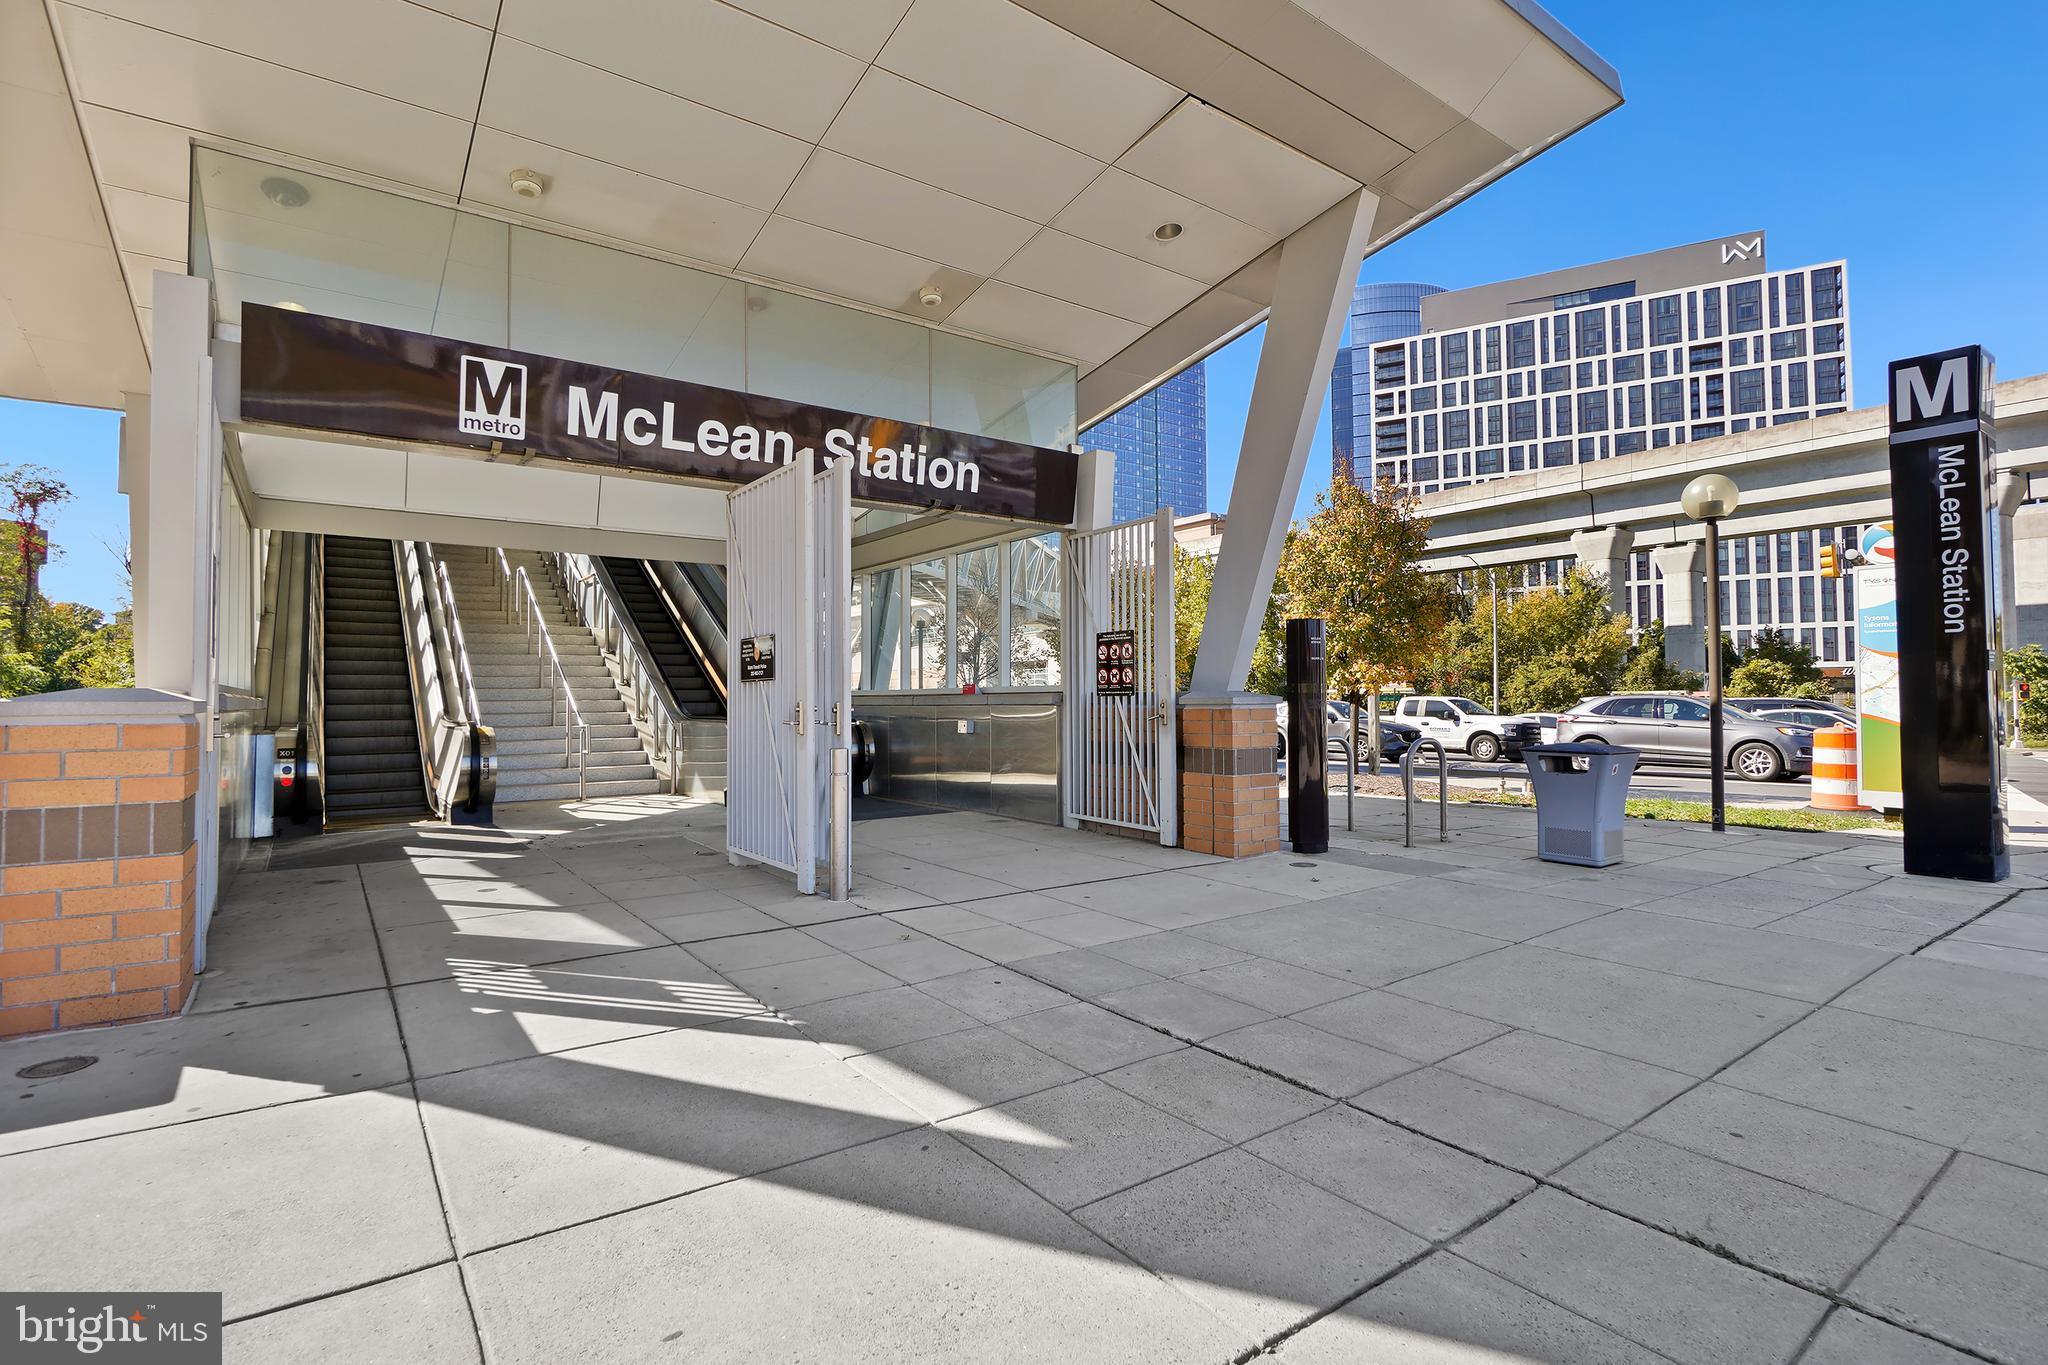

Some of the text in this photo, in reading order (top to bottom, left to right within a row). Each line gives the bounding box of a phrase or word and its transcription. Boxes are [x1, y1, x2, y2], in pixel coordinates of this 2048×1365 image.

[464, 360, 521, 419] M
[1895, 356, 1970, 422] M
[464, 415, 521, 436] metro
[566, 385, 980, 493] McLean Station
[1937, 444, 1970, 634] McLean Station
